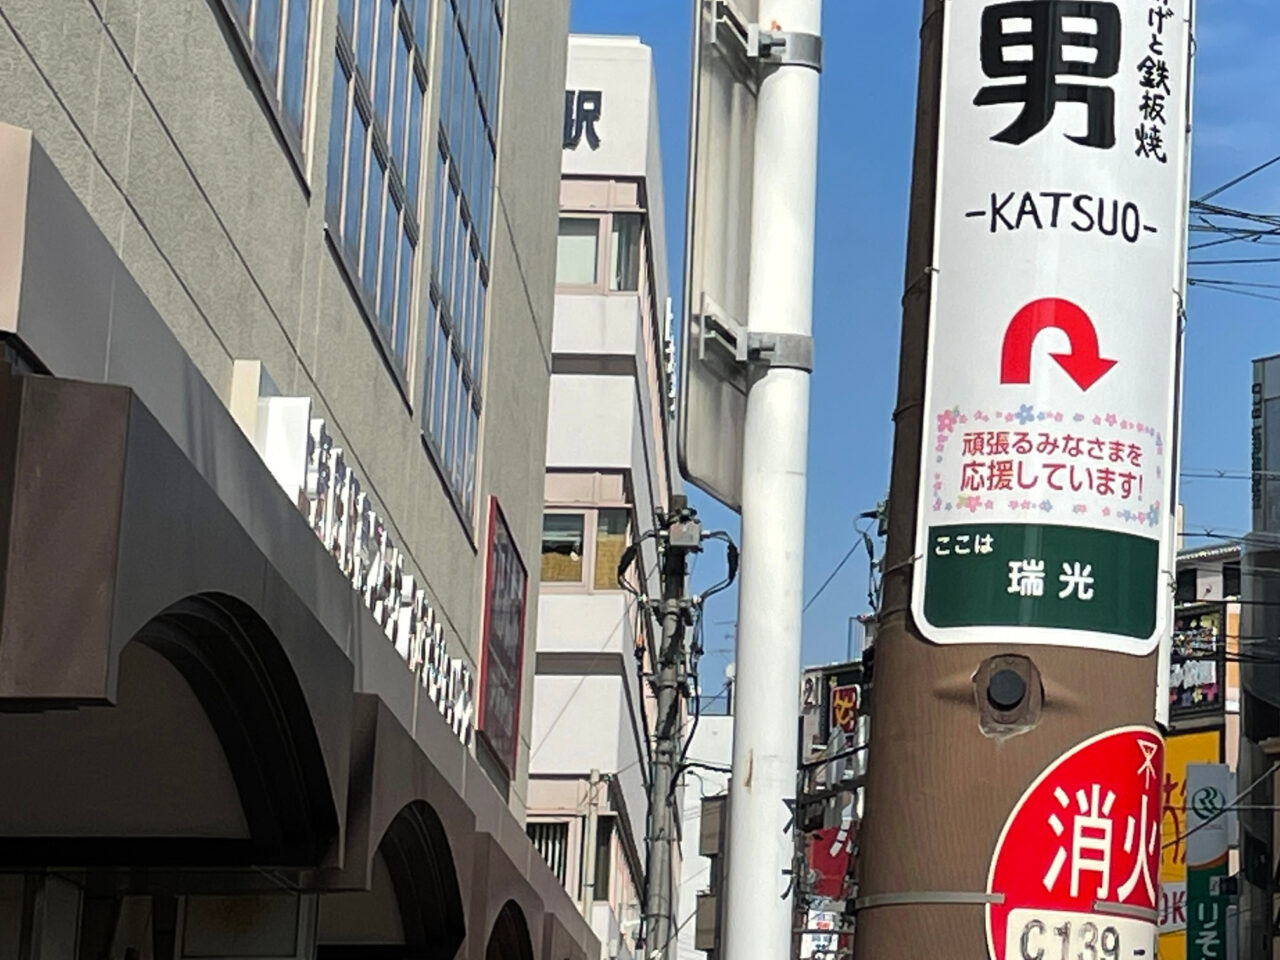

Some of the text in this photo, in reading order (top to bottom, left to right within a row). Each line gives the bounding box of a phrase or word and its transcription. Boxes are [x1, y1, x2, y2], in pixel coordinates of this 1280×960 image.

[962, 431, 1142, 468] 頑張るみなさまを
[935, 533, 994, 555] ここは
[1007, 559, 1095, 600] 瑞光
[1042, 784, 1157, 908] 消火
[1196, 902, 1220, 960] りそ
